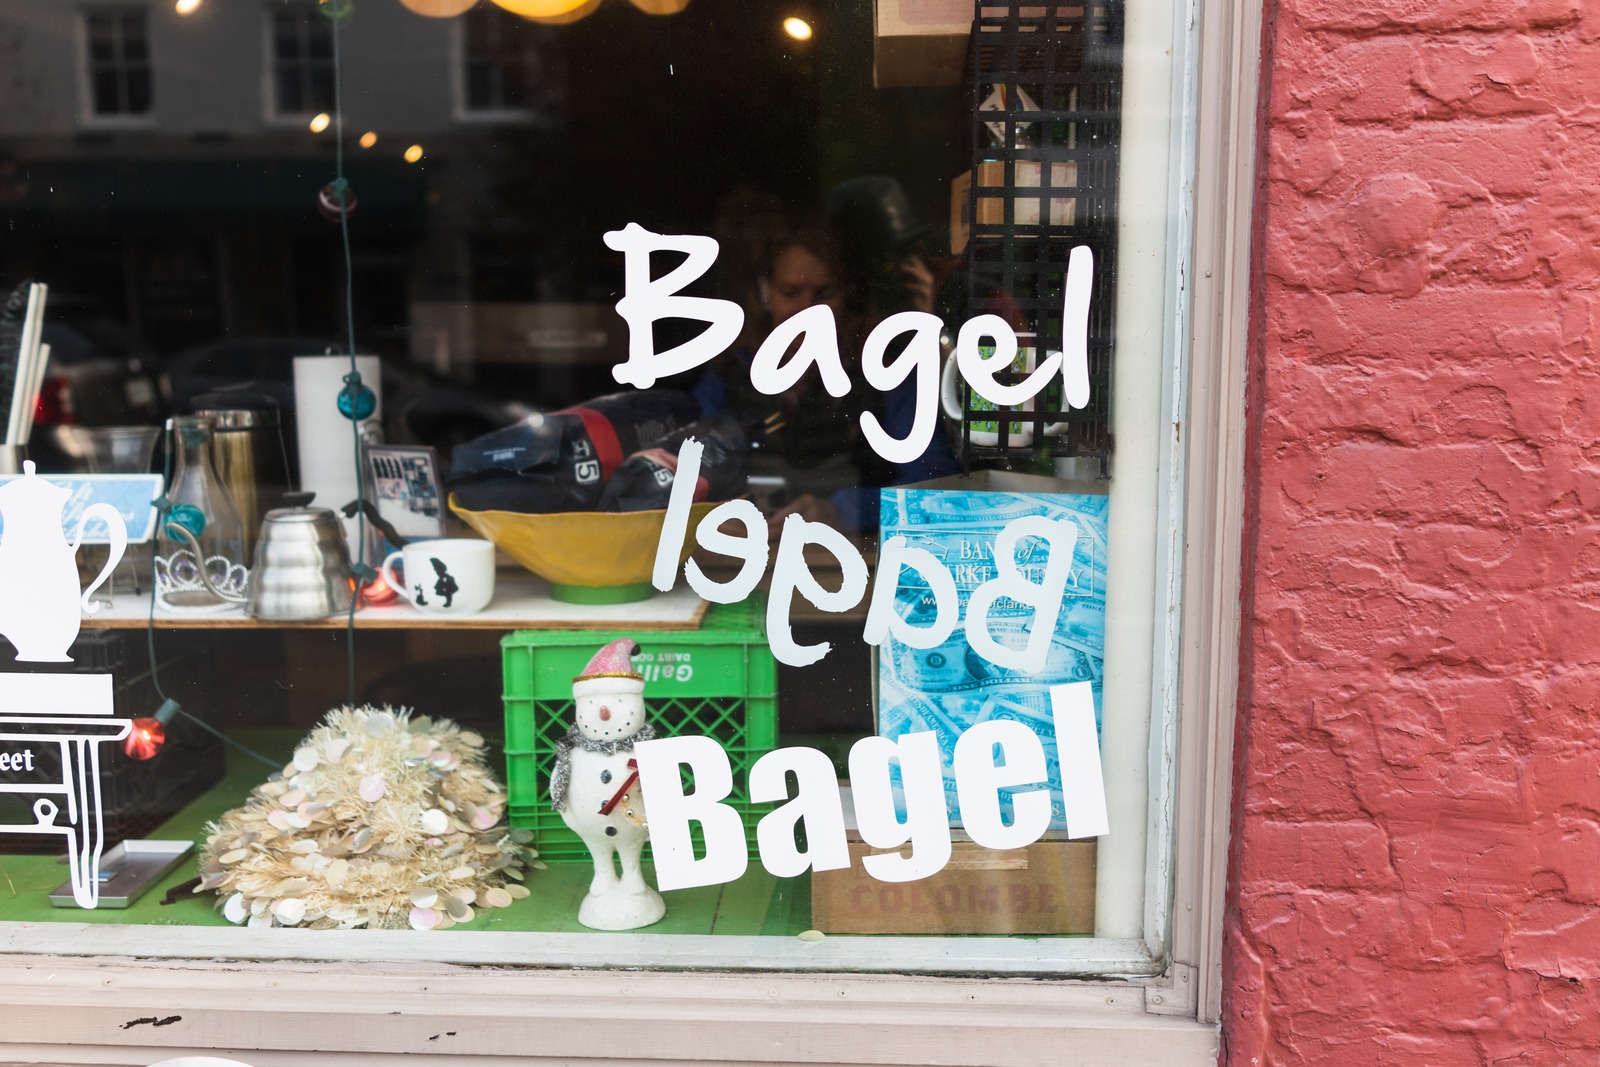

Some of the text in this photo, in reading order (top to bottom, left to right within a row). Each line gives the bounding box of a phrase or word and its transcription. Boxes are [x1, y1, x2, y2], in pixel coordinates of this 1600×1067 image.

[603, 222, 1094, 463] Bagel
[577, 462, 600, 481] 5
[959, 539, 1042, 568] BAN of
[0, 748, 35, 772] eet
[634, 681, 1110, 892] Bagel
[853, 883, 1060, 914] COLOMBE
